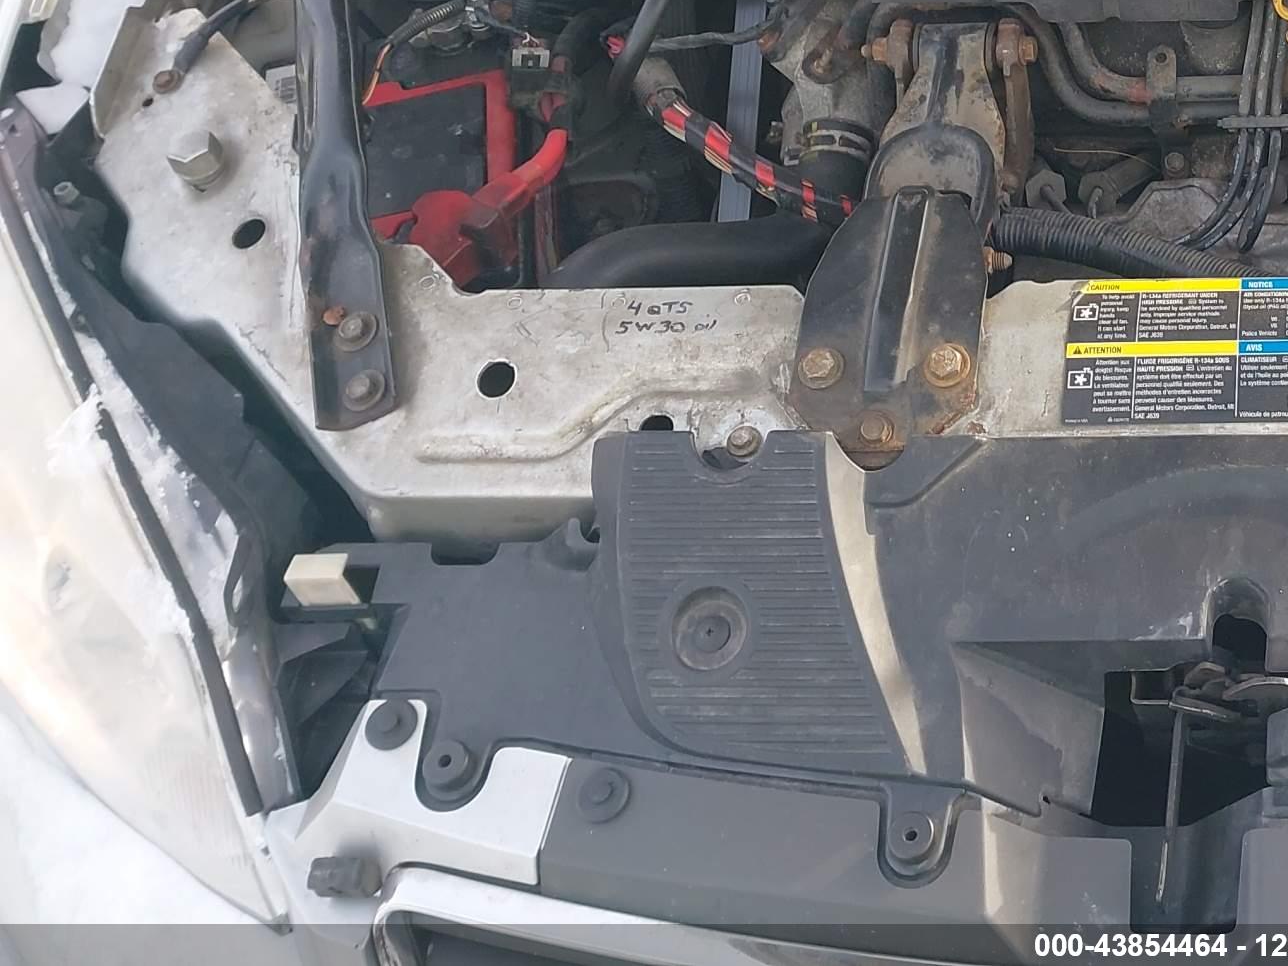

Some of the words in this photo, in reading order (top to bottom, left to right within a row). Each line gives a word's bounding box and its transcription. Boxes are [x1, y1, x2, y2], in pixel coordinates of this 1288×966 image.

[627, 300, 642, 315] 4
[647, 301, 693, 315] QTS
[615, 320, 685, 334] 5W30
